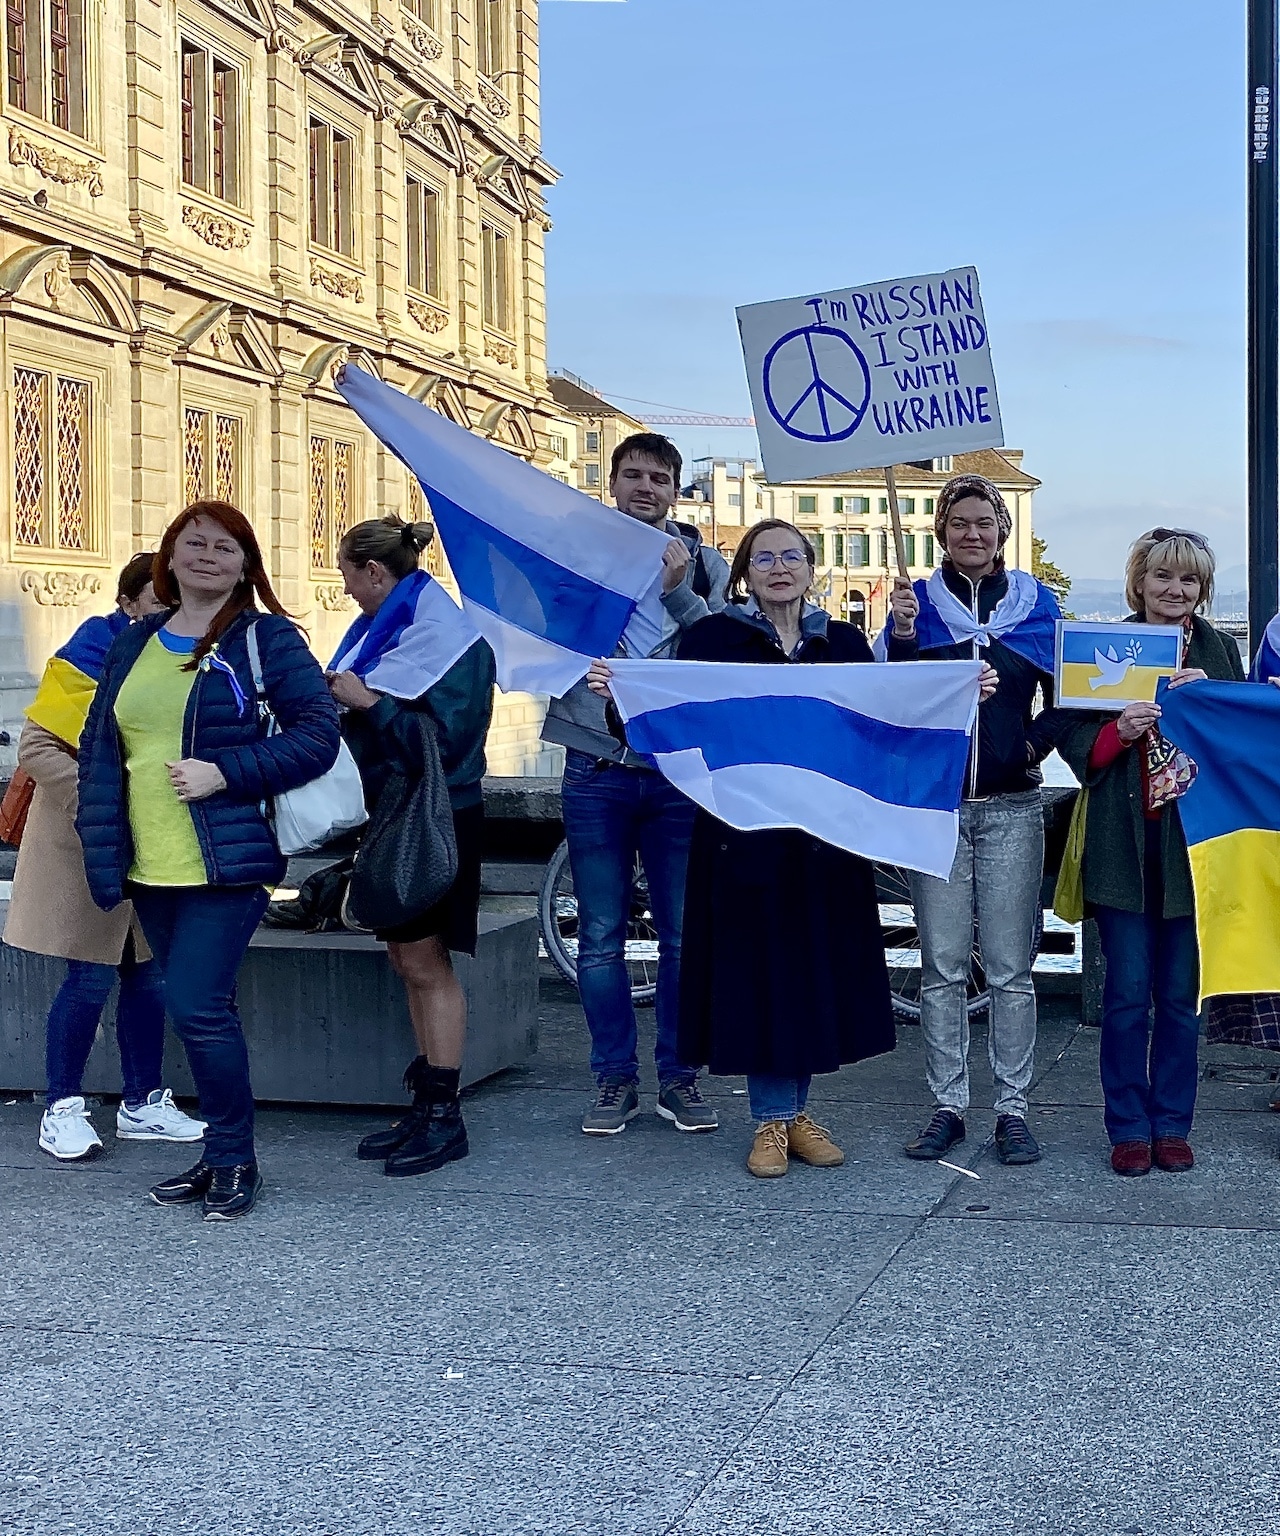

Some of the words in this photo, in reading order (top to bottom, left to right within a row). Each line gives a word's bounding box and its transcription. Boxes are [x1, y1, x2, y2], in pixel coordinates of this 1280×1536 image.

[804, 297, 848, 326] I'm
[852, 275, 975, 330] RUSSIAN
[870, 331, 896, 368] I
[897, 314, 986, 363] STAND
[893, 360, 960, 392] WITH
[872, 386, 992, 436] UKRAINE
